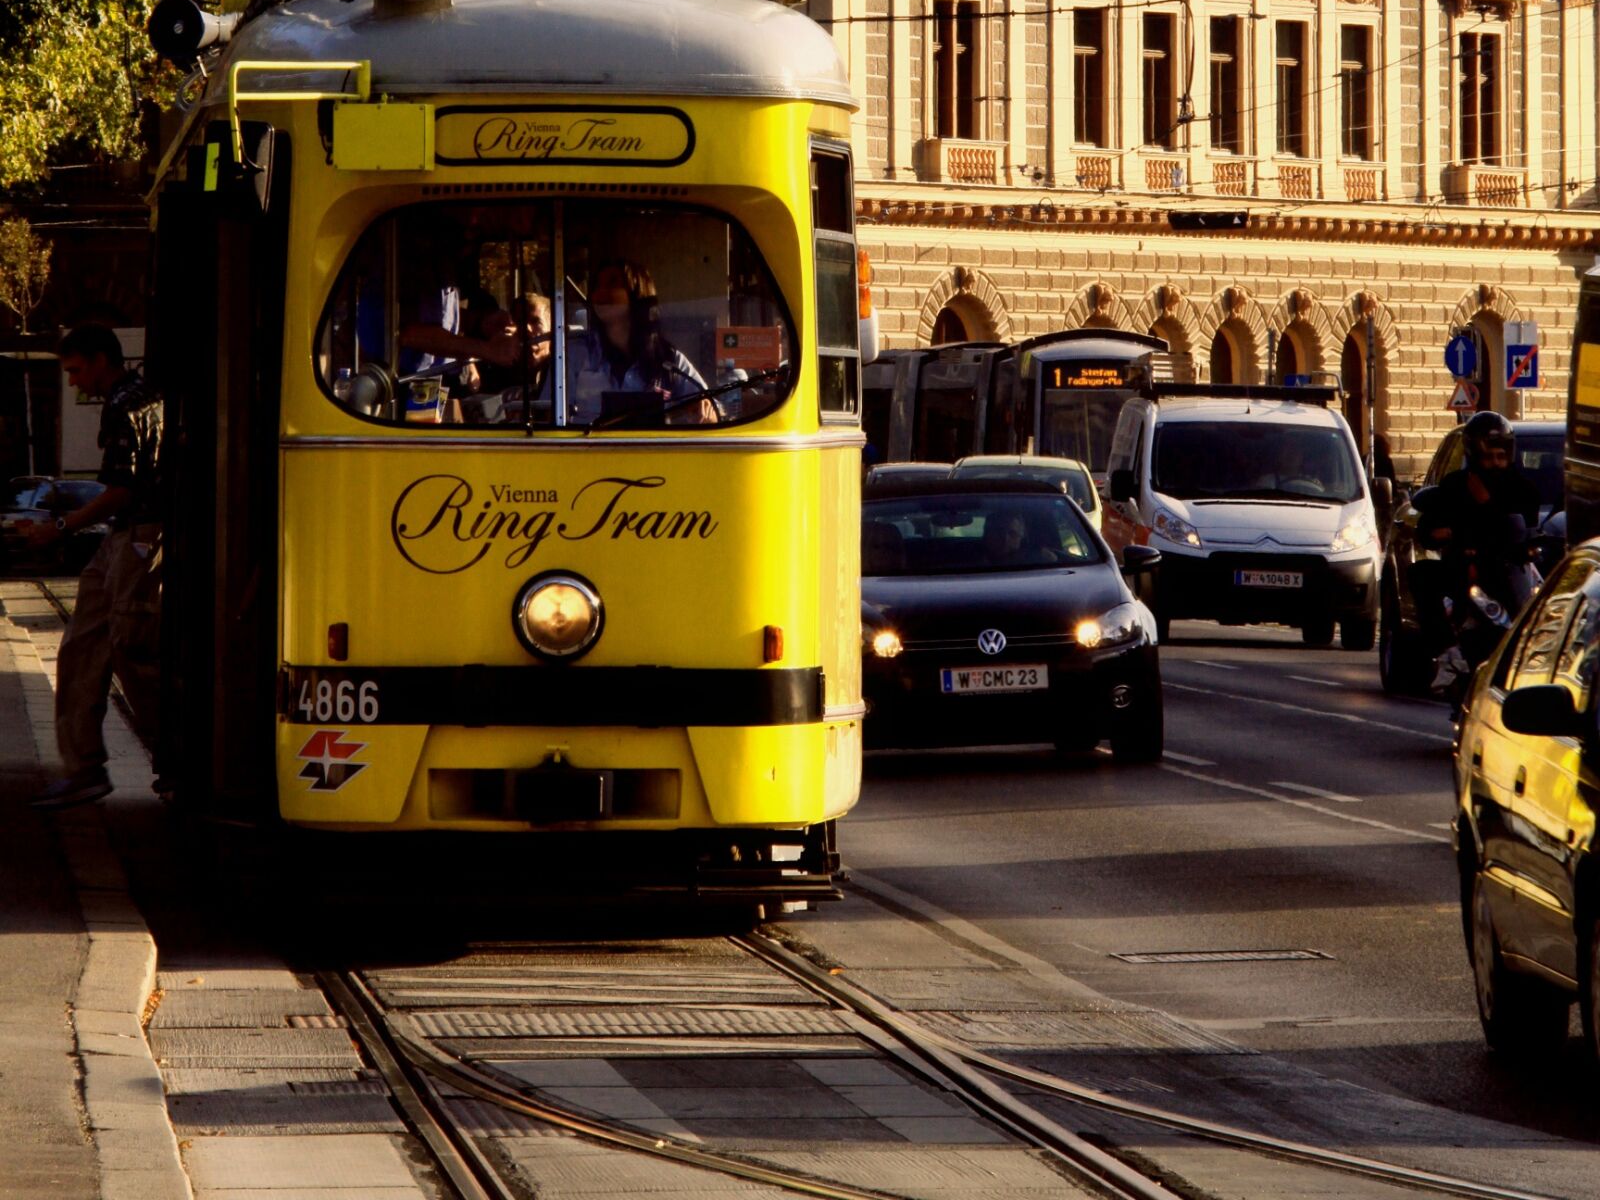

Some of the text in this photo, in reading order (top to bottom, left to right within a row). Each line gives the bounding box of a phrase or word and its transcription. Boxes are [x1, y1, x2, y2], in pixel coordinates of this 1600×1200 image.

[525, 122, 561, 133] Vienna
[474, 117, 645, 159] Ring Tram
[1054, 368, 1061, 387] 1
[1081, 368, 1118, 377] Stefan
[490, 484, 558, 503] Vienna
[391, 474, 719, 574] Ring Tram
[958, 671, 970, 688] W
[982, 670, 1014, 687] CMC
[1018, 669, 1038, 686] 23
[299, 680, 379, 722] 4866
